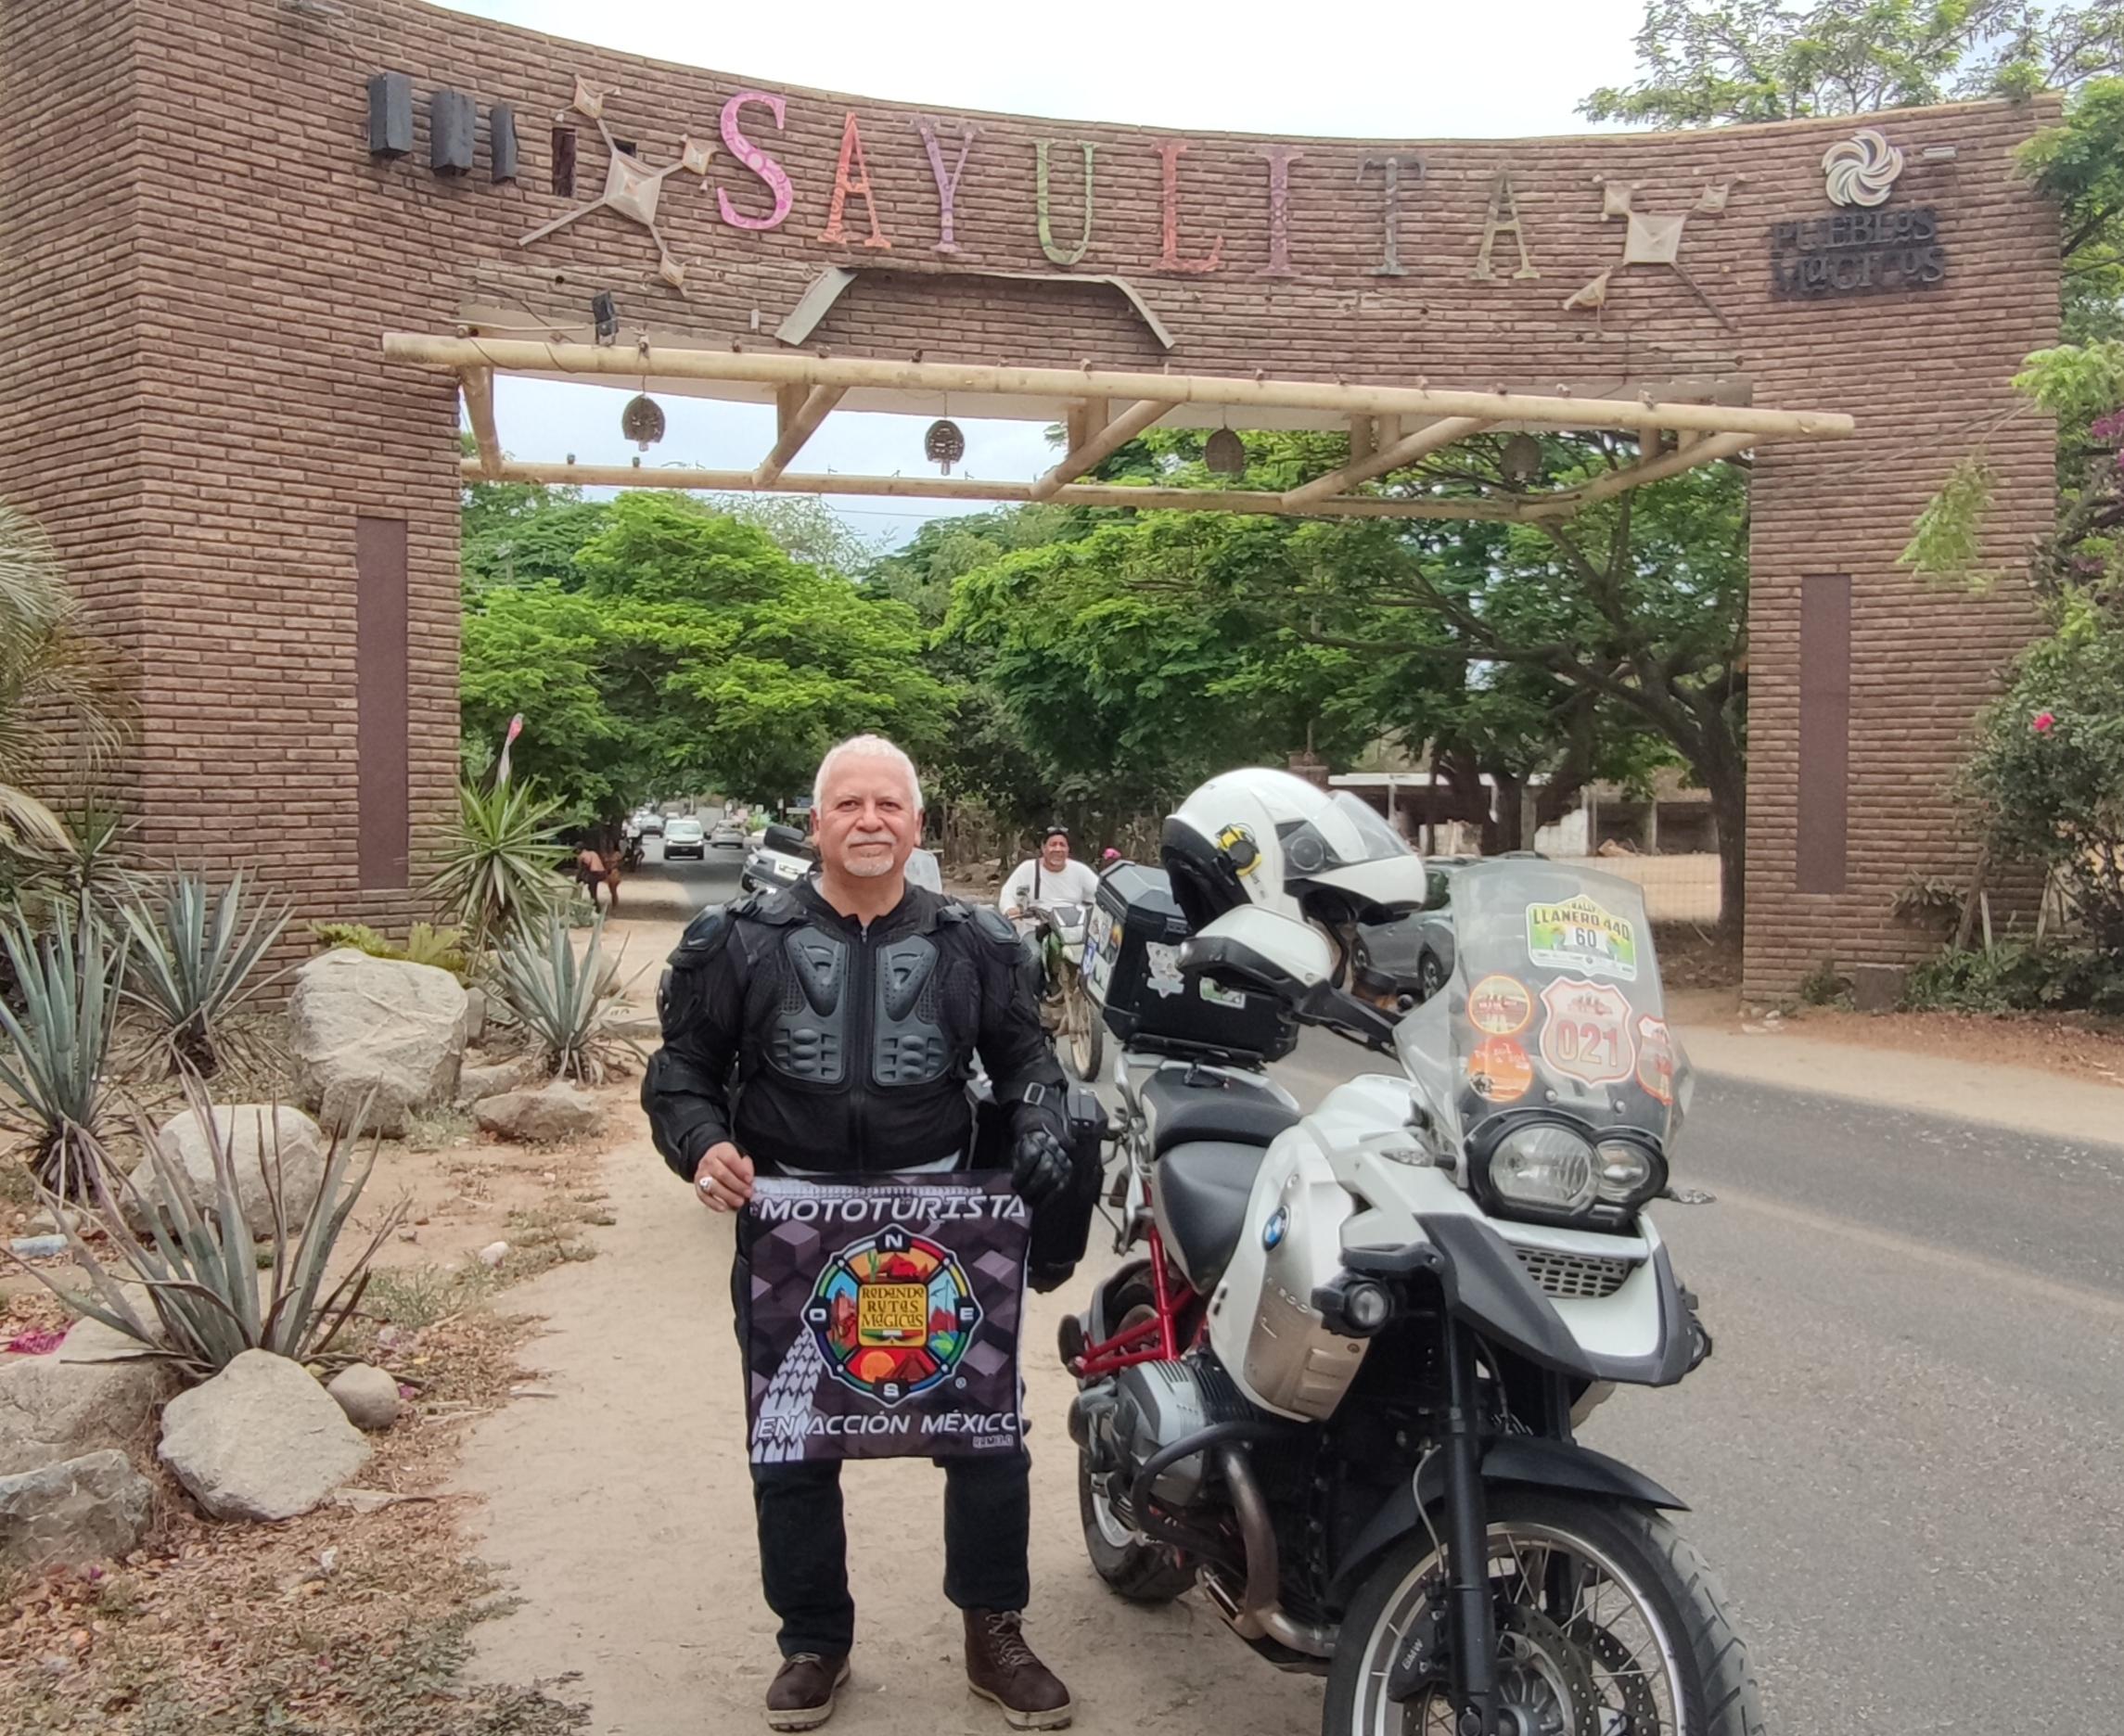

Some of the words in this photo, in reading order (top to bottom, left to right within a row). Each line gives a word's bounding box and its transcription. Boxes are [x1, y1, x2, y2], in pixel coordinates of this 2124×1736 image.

[718, 91, 1540, 280] SAYULITA
[1532, 908, 1599, 926] LLANERO
[1575, 927, 1597, 948] 60
[1556, 1020, 1619, 1067] 021
[760, 1194, 1026, 1223] MOTOTURISTA
[884, 1234, 903, 1248] N
[867, 1300, 919, 1313] RUTAS
[959, 1308, 974, 1320] E
[883, 1383, 900, 1397] S
[758, 1416, 796, 1437] EN
[805, 1410, 910, 1436] ACCIÓN
[1401, 1638, 1424, 1670] BMW
